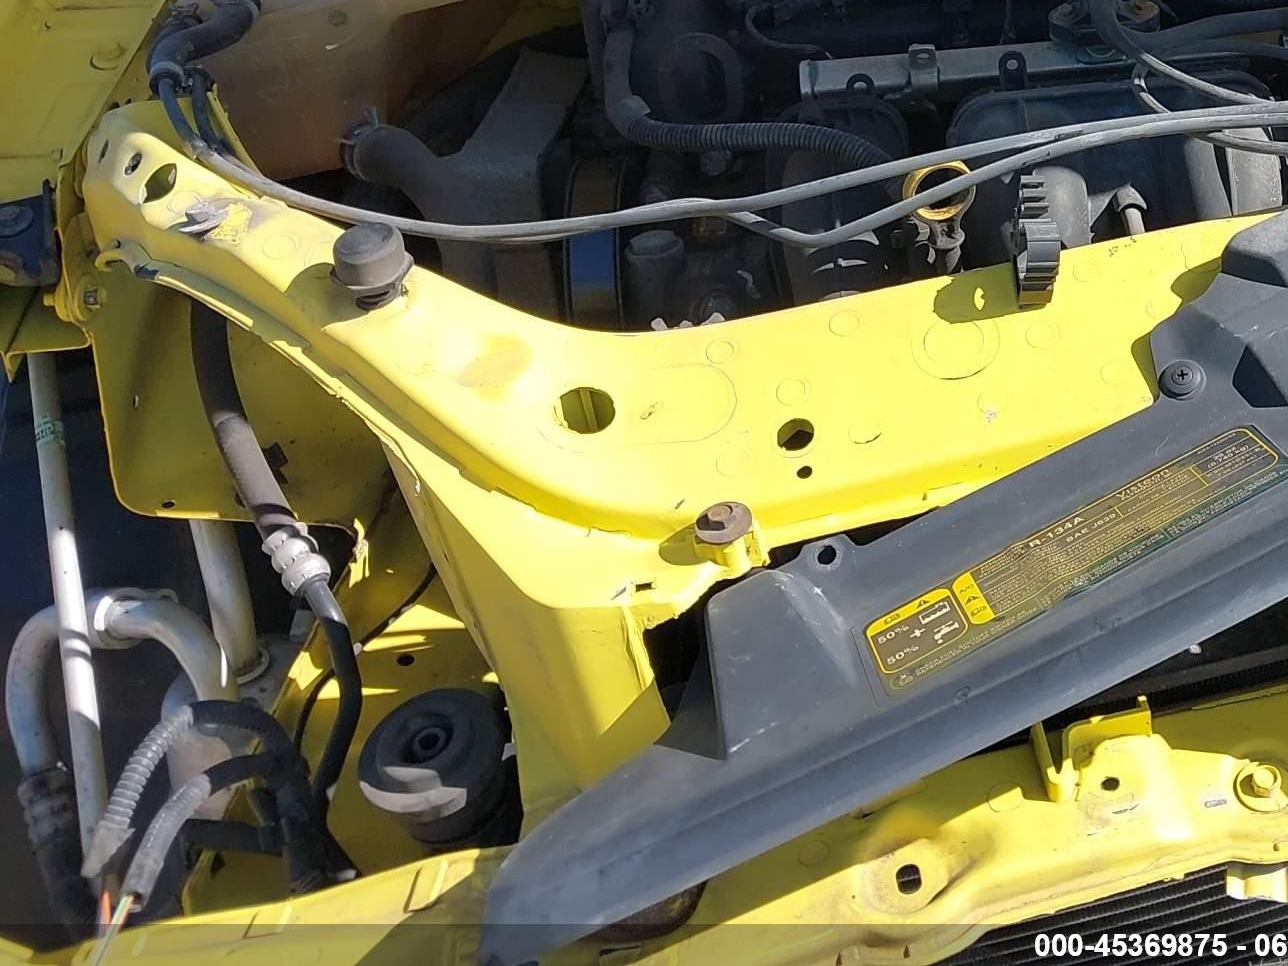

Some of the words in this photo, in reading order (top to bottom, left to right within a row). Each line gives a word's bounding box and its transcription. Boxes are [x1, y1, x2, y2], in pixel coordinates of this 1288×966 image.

[1115, 468, 1170, 498] Visteon
[1028, 516, 1086, 548] R-134A
[1065, 527, 1091, 543] SAE
[877, 625, 910, 645] 50%
[886, 645, 920, 666] 50%
